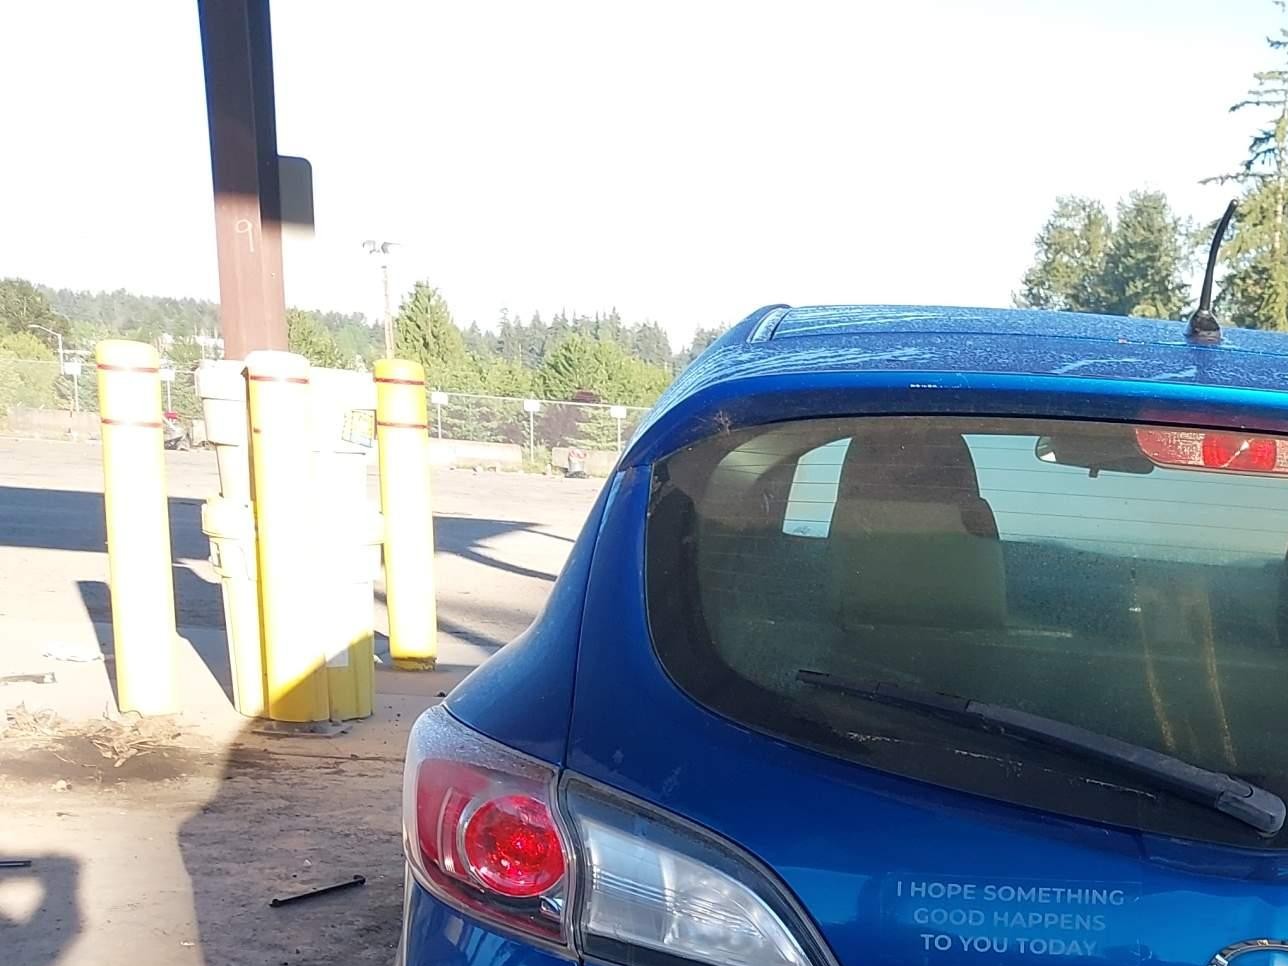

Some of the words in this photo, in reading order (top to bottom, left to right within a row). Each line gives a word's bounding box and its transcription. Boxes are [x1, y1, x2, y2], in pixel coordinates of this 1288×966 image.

[235, 219, 254, 253] 9
[896, 881, 902, 897] I
[910, 881, 977, 900] HOPE
[983, 884, 1125, 906] SOMETHING
[913, 907, 985, 927] GOOD
[993, 911, 1107, 932] HAPPENS
[920, 933, 952, 951] TO
[958, 935, 1009, 954] YOU
[1016, 937, 1097, 956] TODAY
